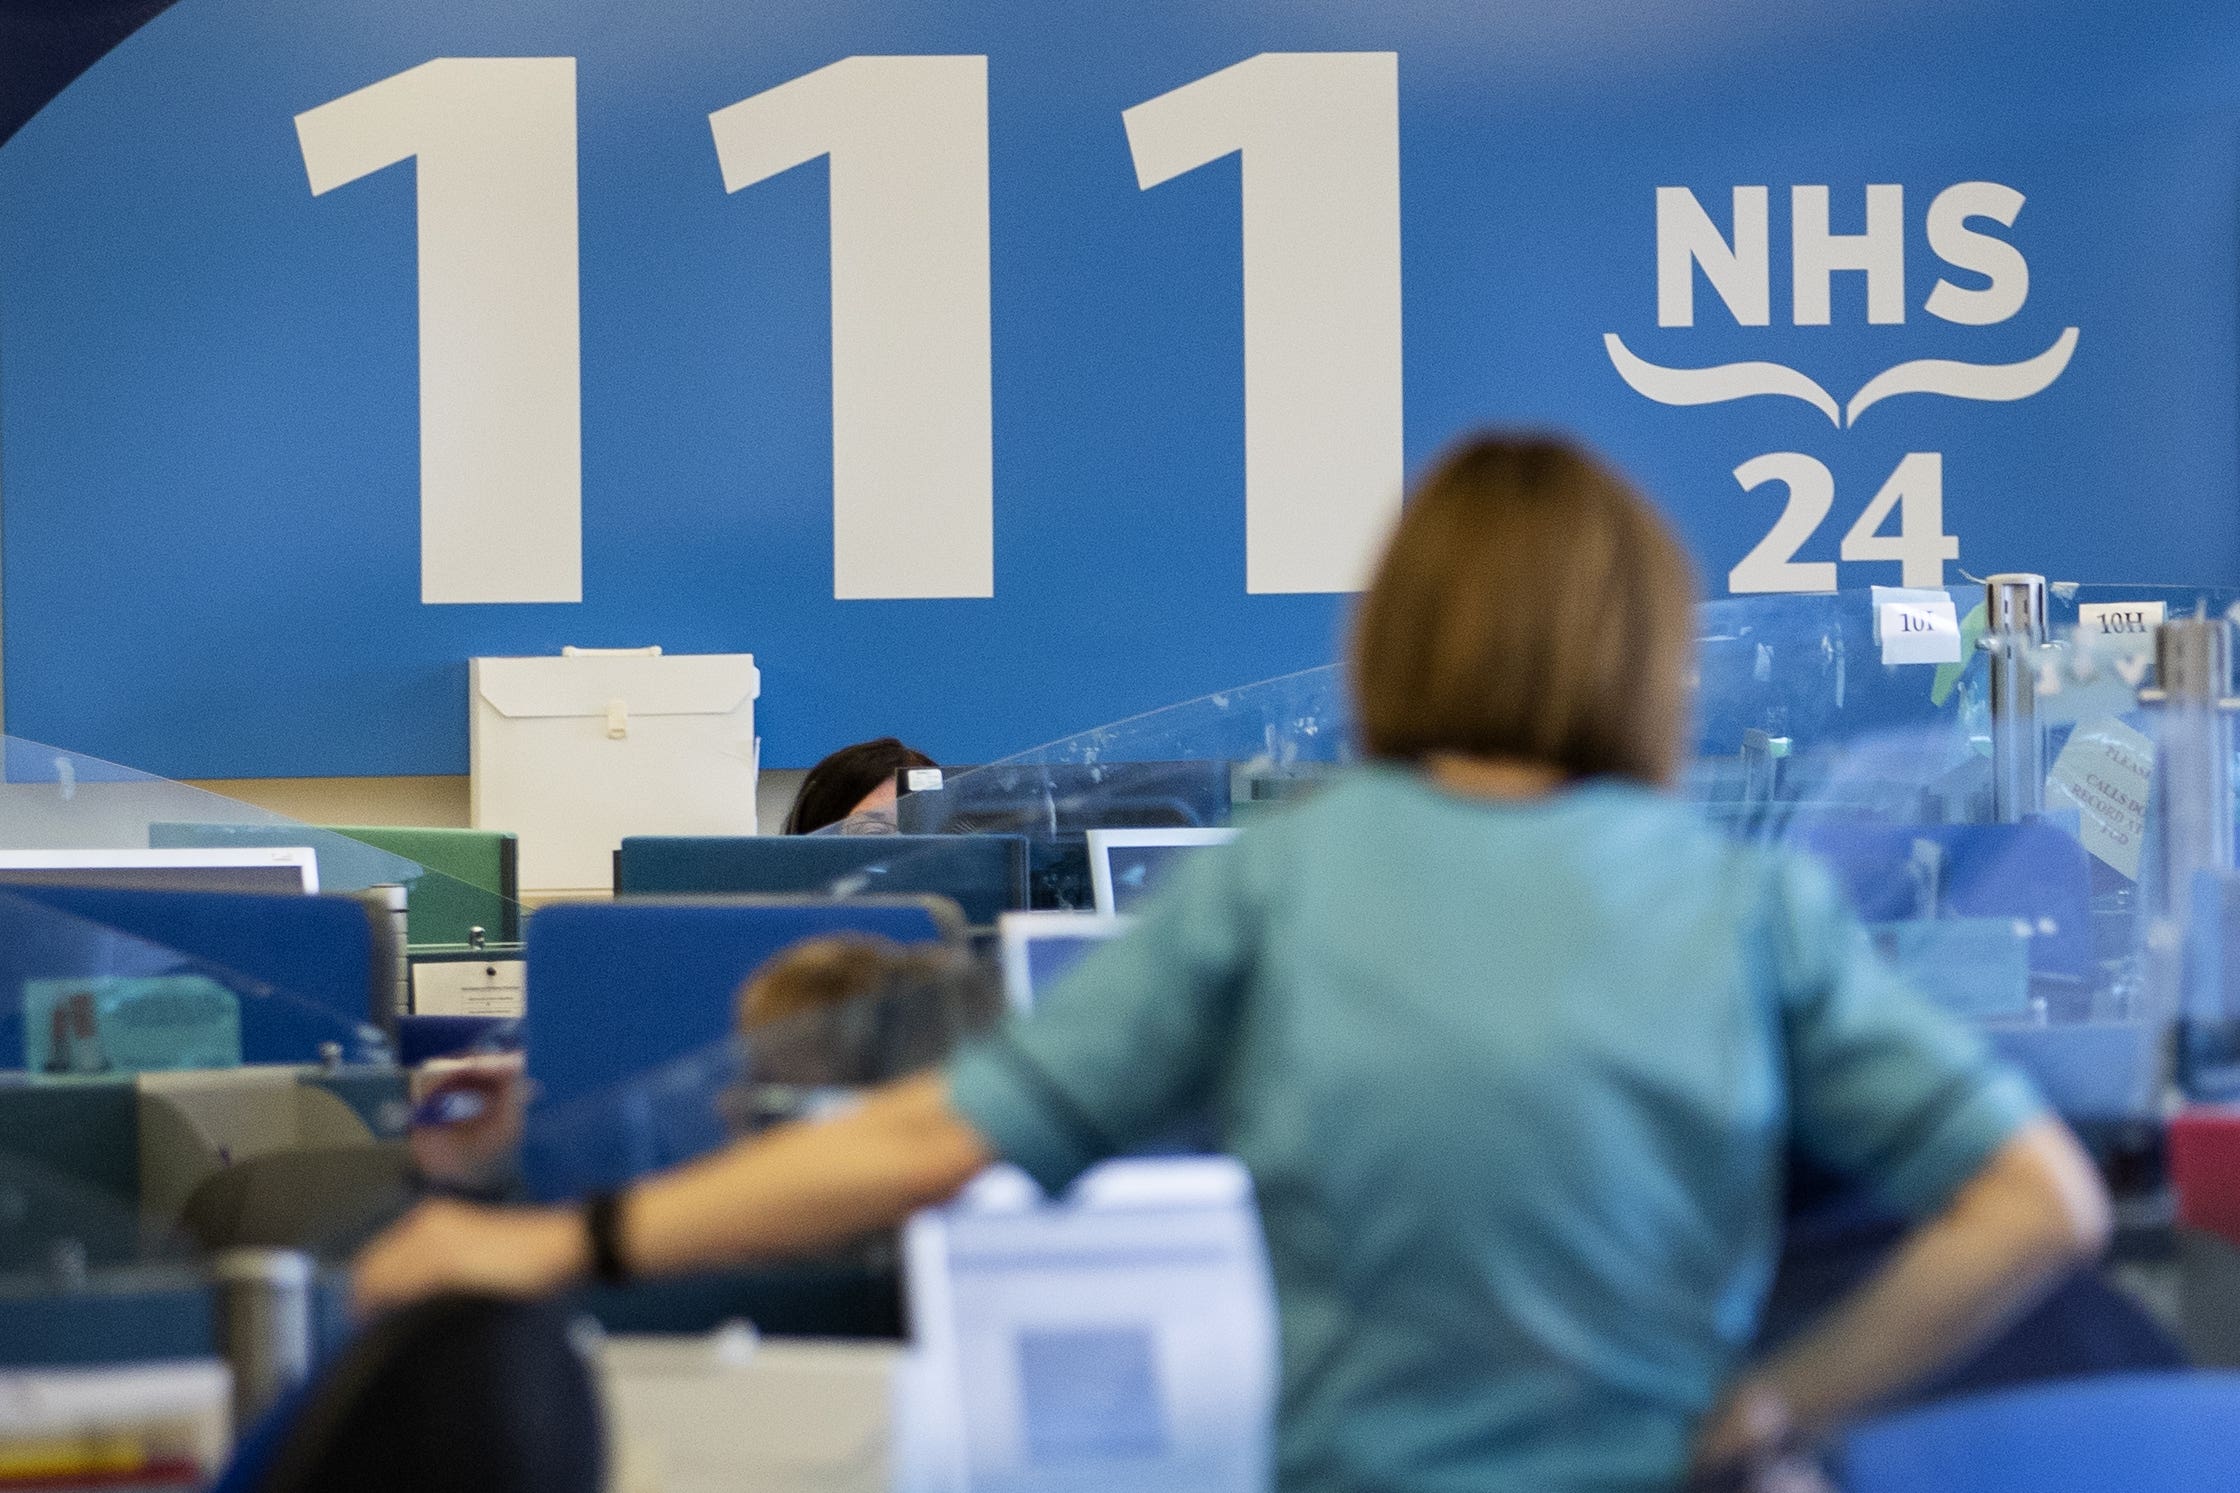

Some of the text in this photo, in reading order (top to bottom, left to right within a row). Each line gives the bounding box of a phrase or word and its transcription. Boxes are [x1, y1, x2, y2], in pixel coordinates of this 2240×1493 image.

[1655, 181, 2029, 328] NHS
[294, 51, 1404, 604] 111
[1728, 452, 1960, 595] 24
[2096, 611, 2146, 634] 10H
[2070, 783, 2124, 822] RECORD
[2086, 773, 2128, 805] CALLS
